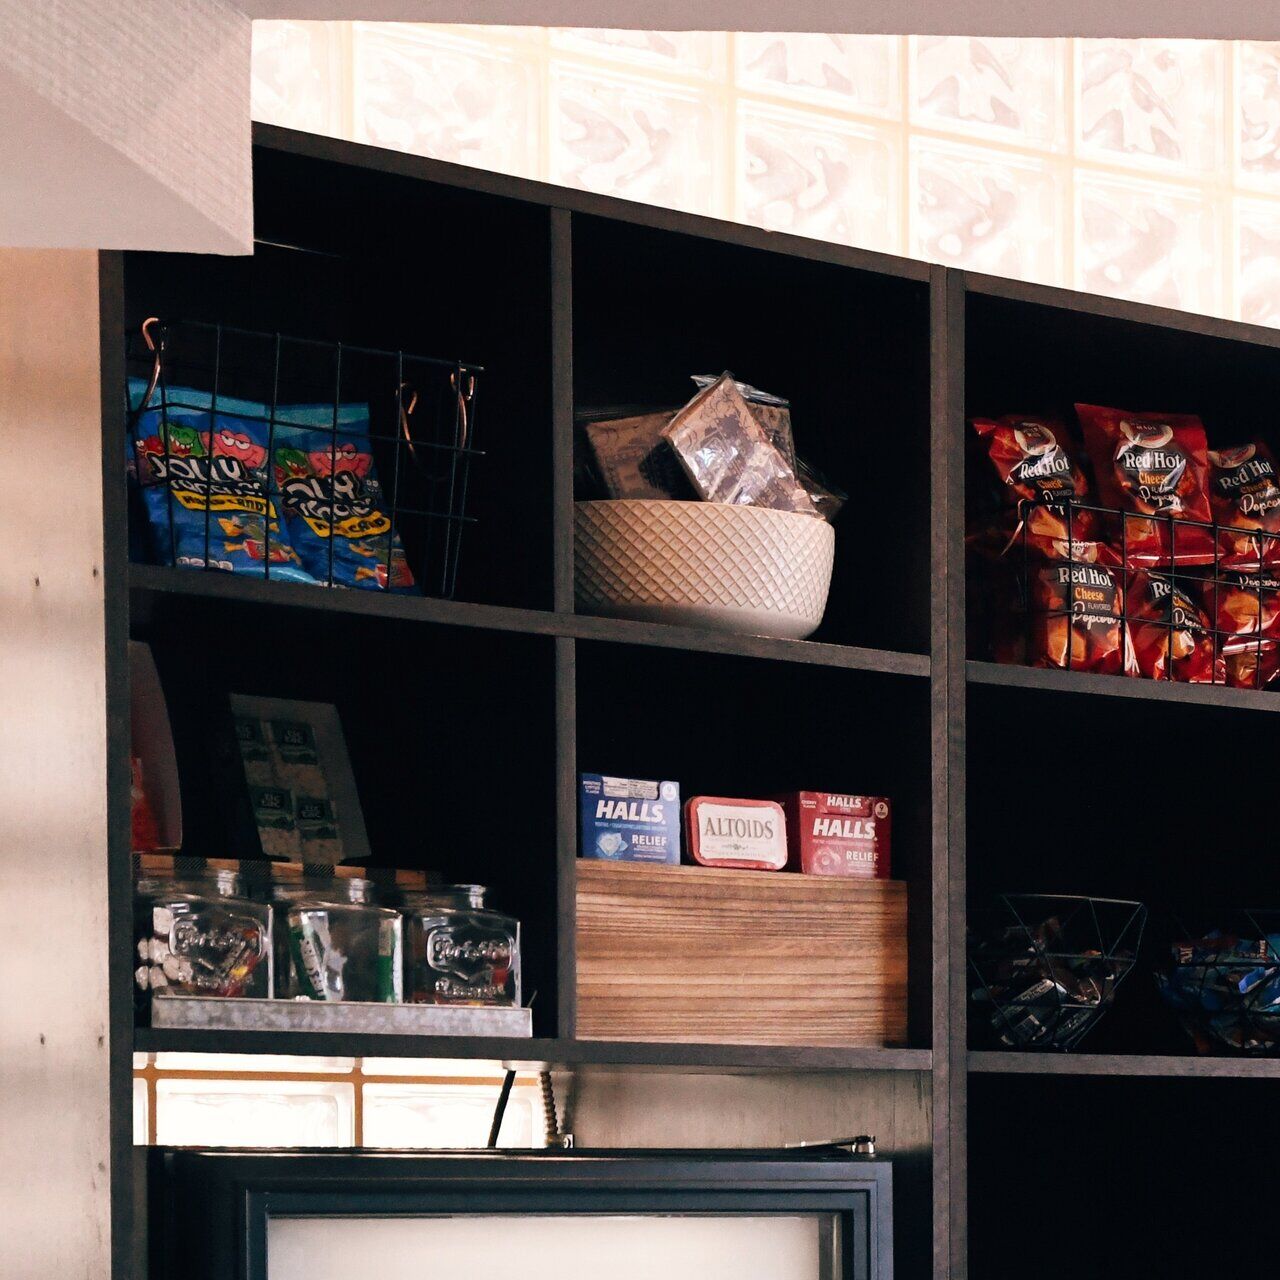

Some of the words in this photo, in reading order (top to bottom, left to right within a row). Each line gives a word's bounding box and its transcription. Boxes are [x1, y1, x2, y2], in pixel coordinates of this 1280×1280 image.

[1020, 457, 1045, 479] Red
[1045, 455, 1070, 474] Hot
[1124, 452, 1152, 469] Red
[1154, 451, 1182, 469] Hot
[1219, 467, 1249, 490] Red
[1247, 460, 1273, 477] Hot
[1057, 566, 1087, 586] Red
[1089, 569, 1113, 587] Hot
[1074, 588, 1104, 601] Cheese
[1072, 601, 1121, 630] Popcorn
[826, 794, 863, 809] HALLS
[596, 800, 665, 825] HALLS
[704, 817, 774, 839] ALTOIDS
[812, 818, 878, 841] HALLS
[632, 834, 667, 847] RELIEF
[846, 851, 879, 862] RELIEF
